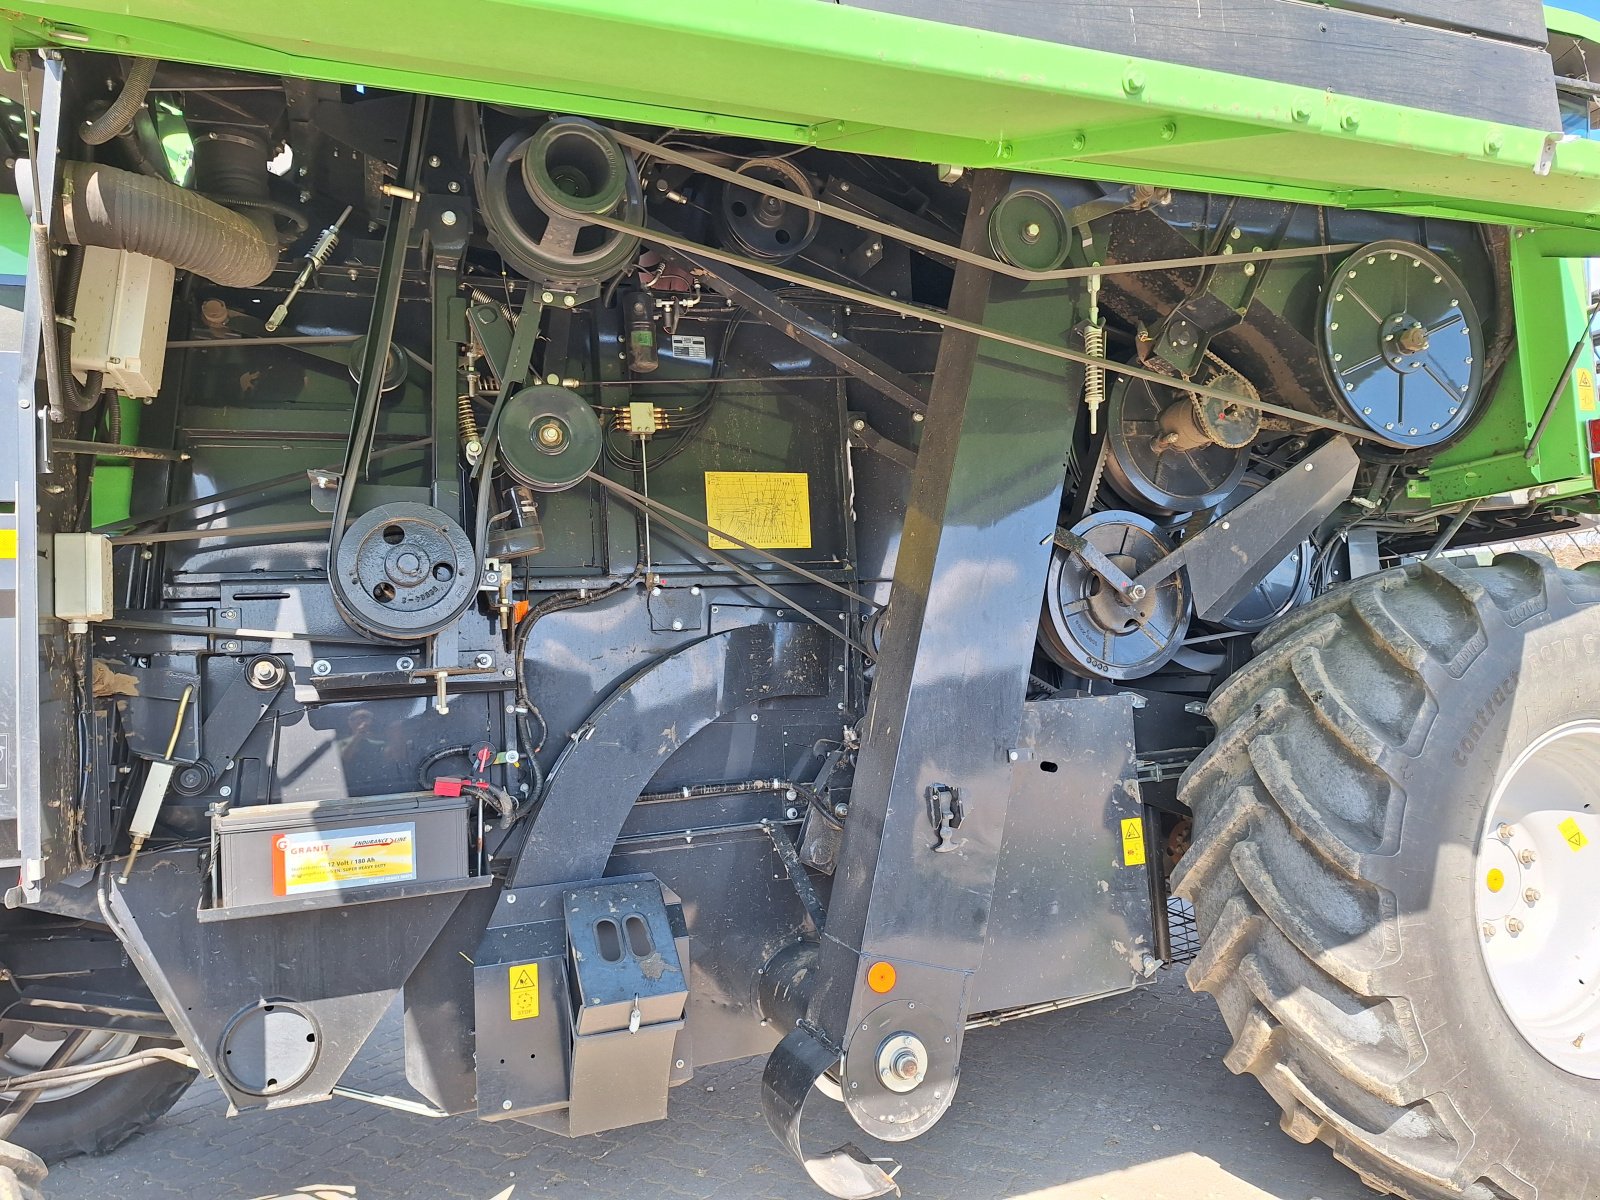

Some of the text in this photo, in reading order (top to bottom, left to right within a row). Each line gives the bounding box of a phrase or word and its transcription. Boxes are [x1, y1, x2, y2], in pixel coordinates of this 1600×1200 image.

[1449, 635, 1486, 677] RADIAL
[1451, 669, 1522, 768] contract
[354, 837, 389, 846] ENDURANCE
[290, 844, 331, 855] GRANIT
[336, 859, 349, 867] Volt
